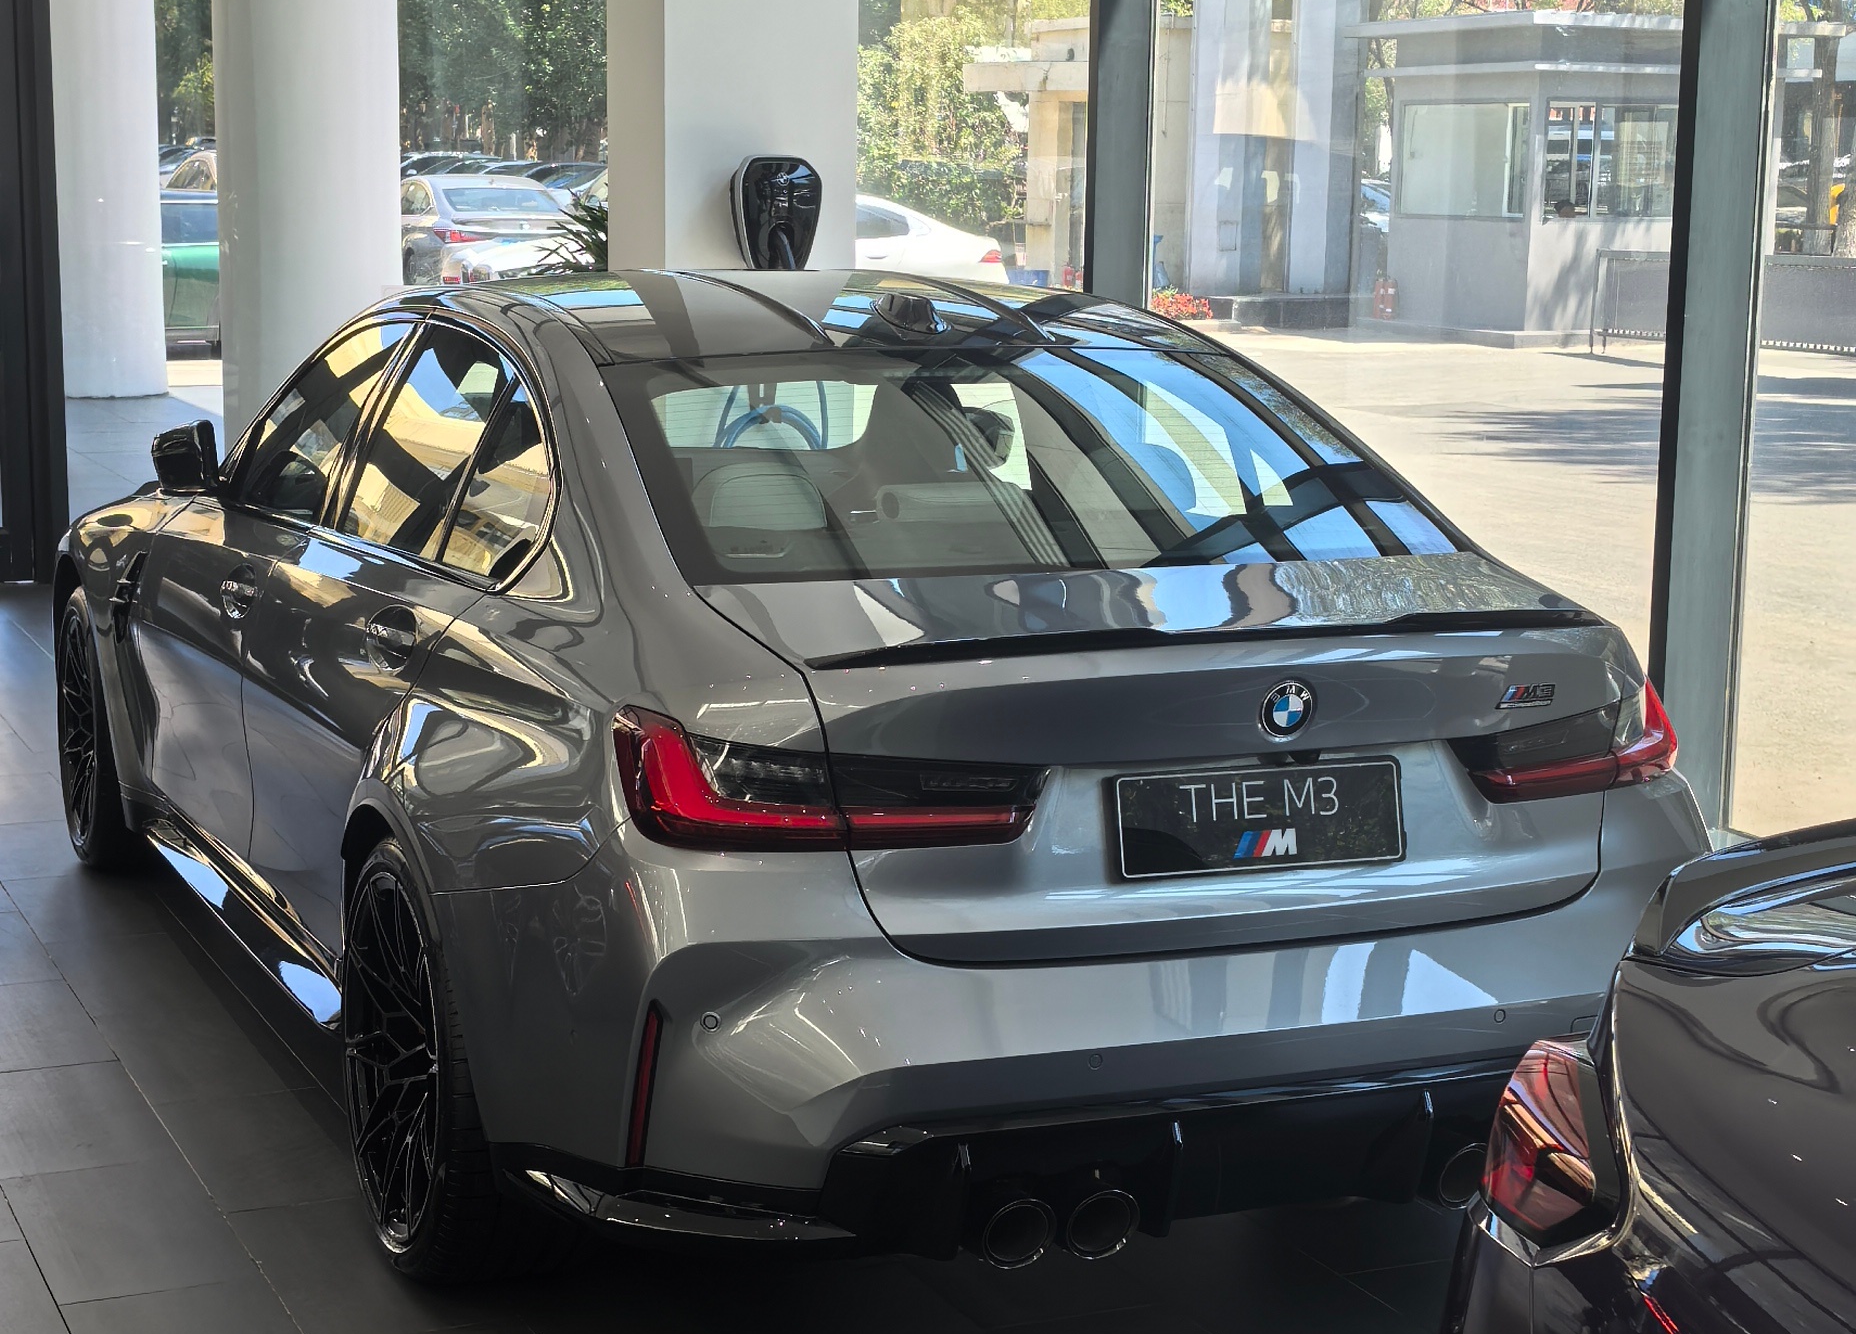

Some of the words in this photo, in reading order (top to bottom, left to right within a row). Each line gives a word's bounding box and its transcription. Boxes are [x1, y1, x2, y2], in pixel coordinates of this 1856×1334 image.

[1178, 780, 1267, 823] THE
[1283, 776, 1340, 817] M3
[1258, 827, 1298, 857] M
